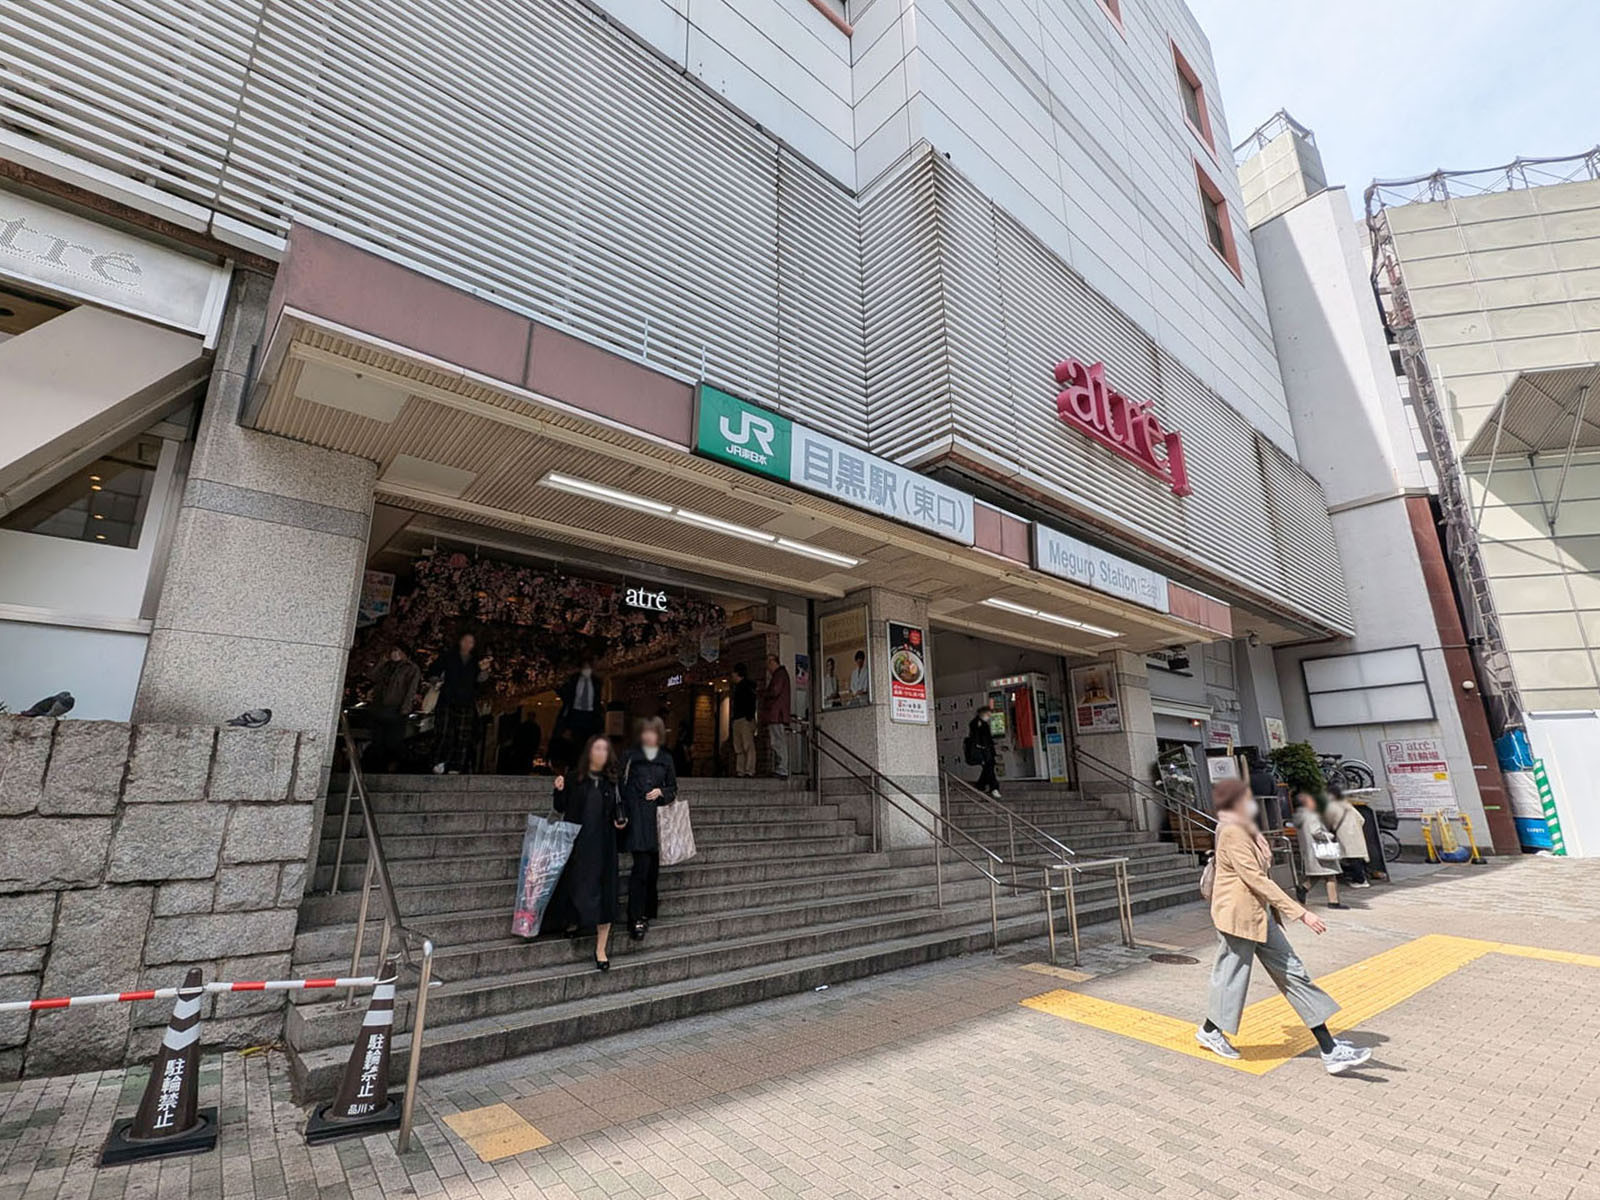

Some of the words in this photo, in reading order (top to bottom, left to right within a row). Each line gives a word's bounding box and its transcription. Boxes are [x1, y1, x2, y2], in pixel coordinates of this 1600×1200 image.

[720, 410, 774, 457] JR
[1055, 357, 1170, 471] atré
[726, 444, 767, 466] JR東日本
[1049, 539, 1096, 579] Meguro
[1100, 559, 1138, 595] Station
[625, 587, 667, 611] atré
[153, 1058, 185, 1129] 駐輪禁止
